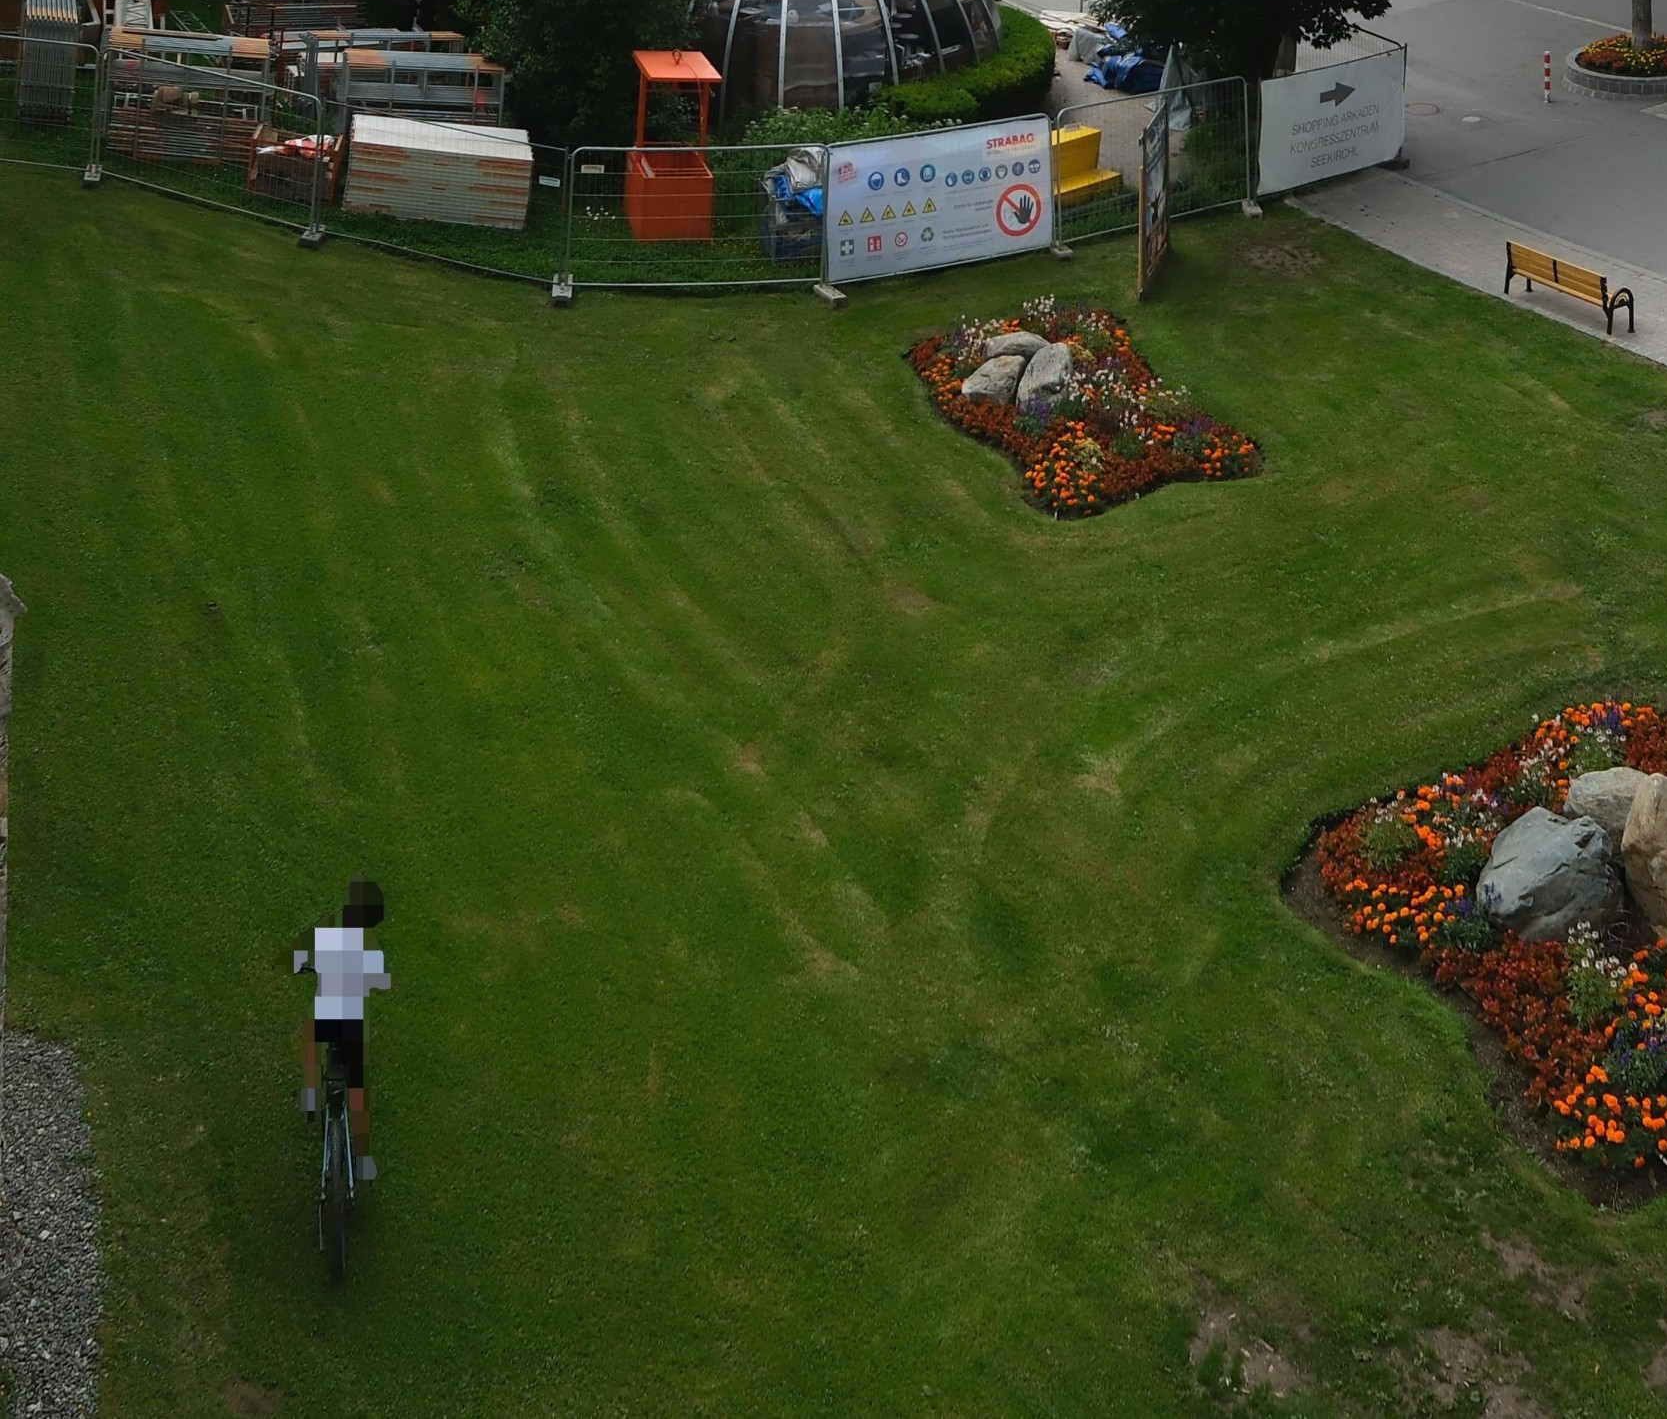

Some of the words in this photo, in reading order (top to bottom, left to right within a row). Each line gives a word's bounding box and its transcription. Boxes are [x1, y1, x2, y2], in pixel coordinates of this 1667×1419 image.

[1291, 115, 1339, 136] SHOPPING
[1340, 104, 1380, 124] ARKADEN
[986, 133, 1035, 149] STRABAG
[1289, 121, 1379, 155] KONGRESSZENTRUM
[1310, 146, 1359, 169] SEEKIRCHL
